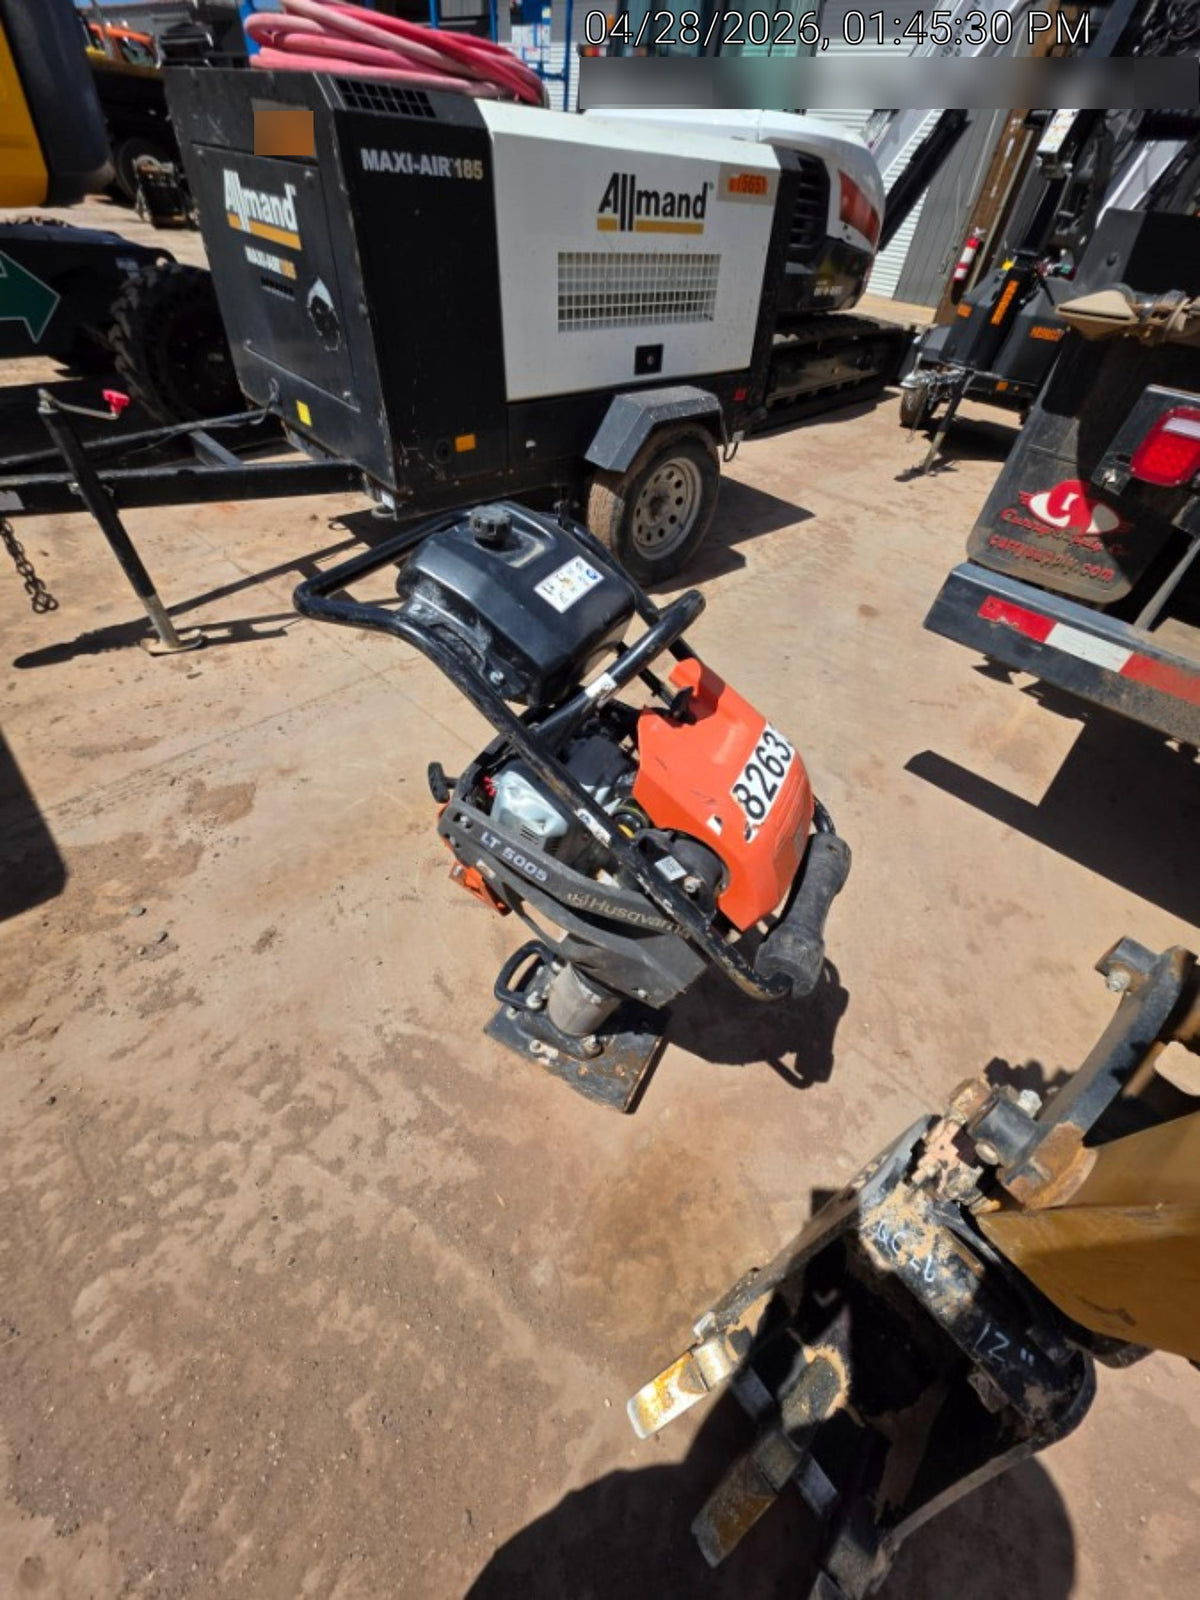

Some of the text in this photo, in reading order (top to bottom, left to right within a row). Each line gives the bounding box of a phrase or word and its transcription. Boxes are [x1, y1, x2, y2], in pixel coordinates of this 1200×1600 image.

[454, 158, 484, 180] 185
[223, 168, 299, 233] Allmand
[598, 172, 708, 232] Allmand
[480, 831, 550, 883] LT 5005
[590, 896, 693, 940] Husqvarna
